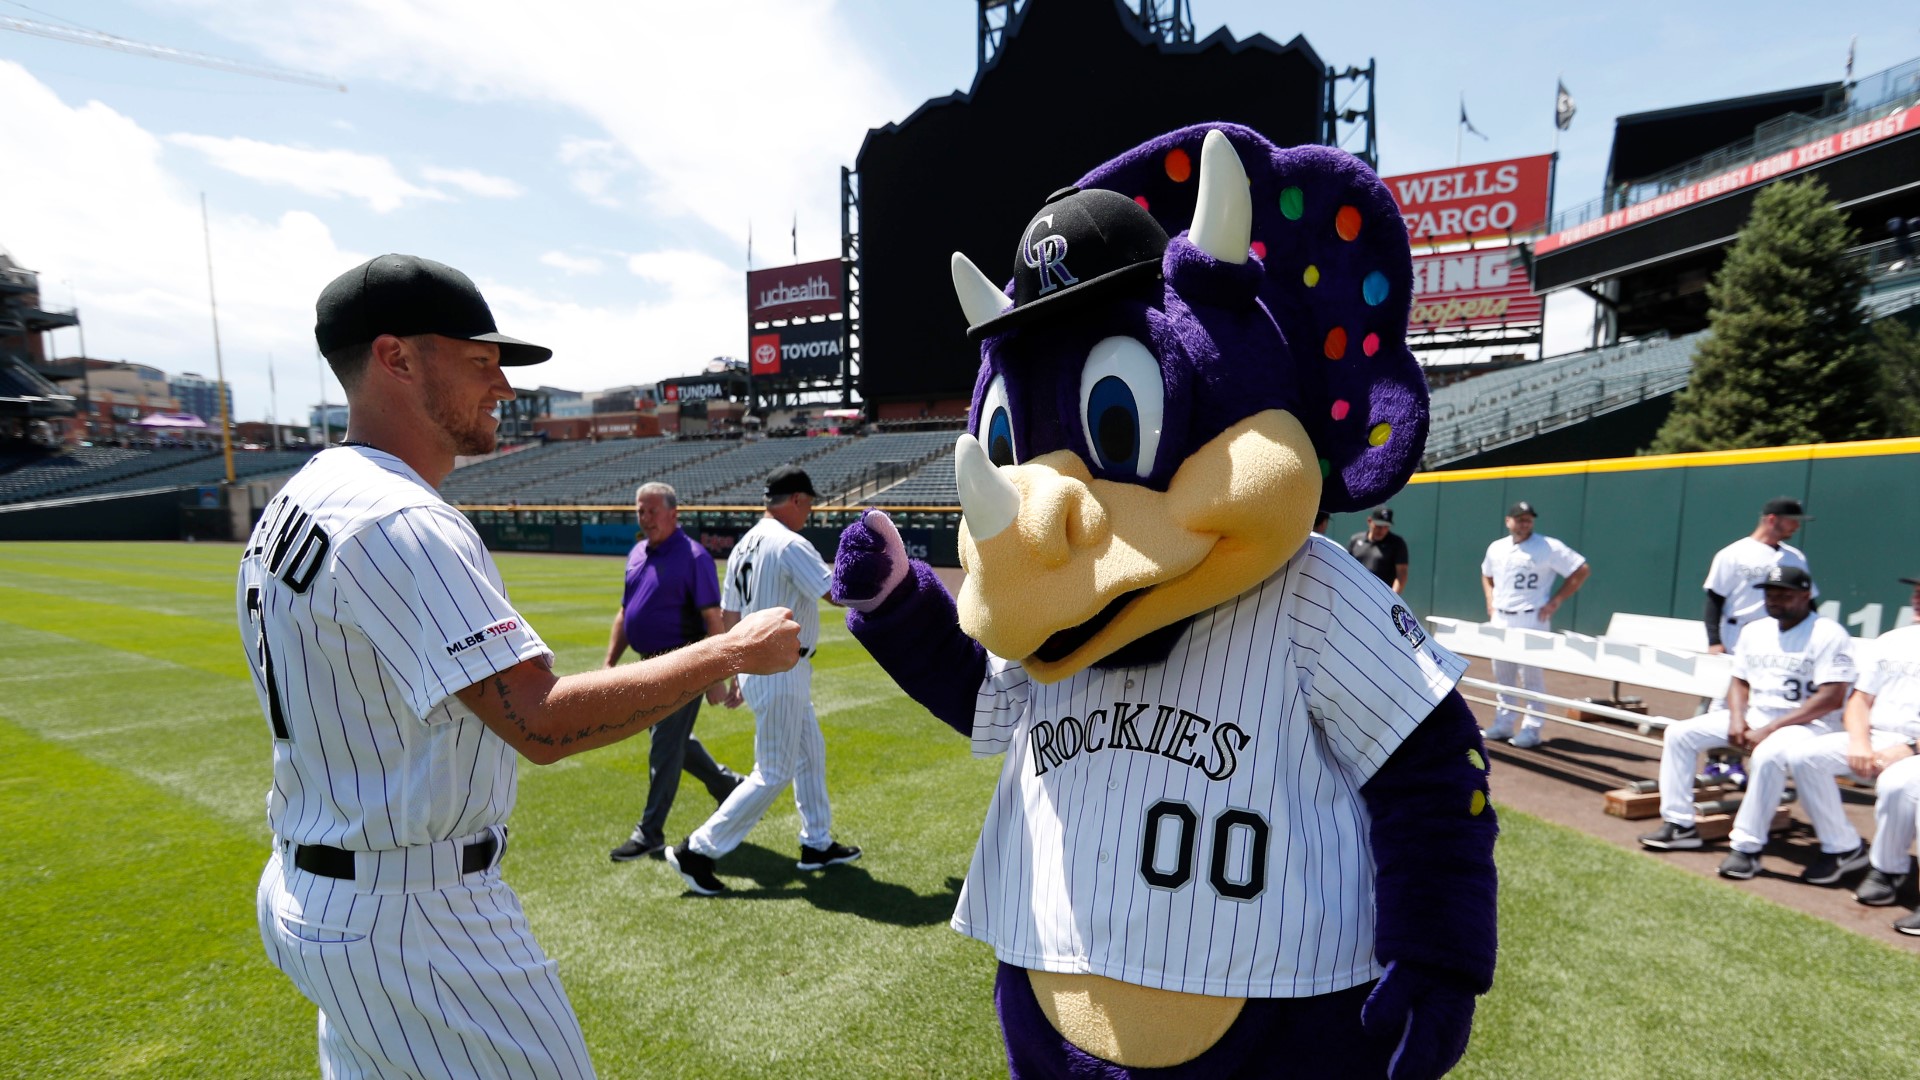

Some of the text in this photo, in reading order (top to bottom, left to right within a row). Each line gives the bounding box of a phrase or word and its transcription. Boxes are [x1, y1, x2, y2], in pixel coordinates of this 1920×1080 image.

[1627, 185, 1696, 224] RENEWABLE
[1698, 166, 1748, 200] ENERGY
[1752, 151, 1793, 182] FROM
[1796, 137, 1835, 164] XCEL
[1841, 111, 1907, 147] ENERGY
[1396, 165, 1519, 206] WELLS
[1400, 201, 1518, 239] FARGO
[760, 275, 830, 307] uchealth
[1411, 297, 1509, 328] oopers
[781, 340, 840, 361] TOYOTA
[677, 383, 723, 400] TUNDRA
[1514, 573, 1539, 590] 22
[446, 636, 477, 656] MLB
[1030, 701, 1252, 781] ROCKIES
[1137, 797, 1273, 905] 00
